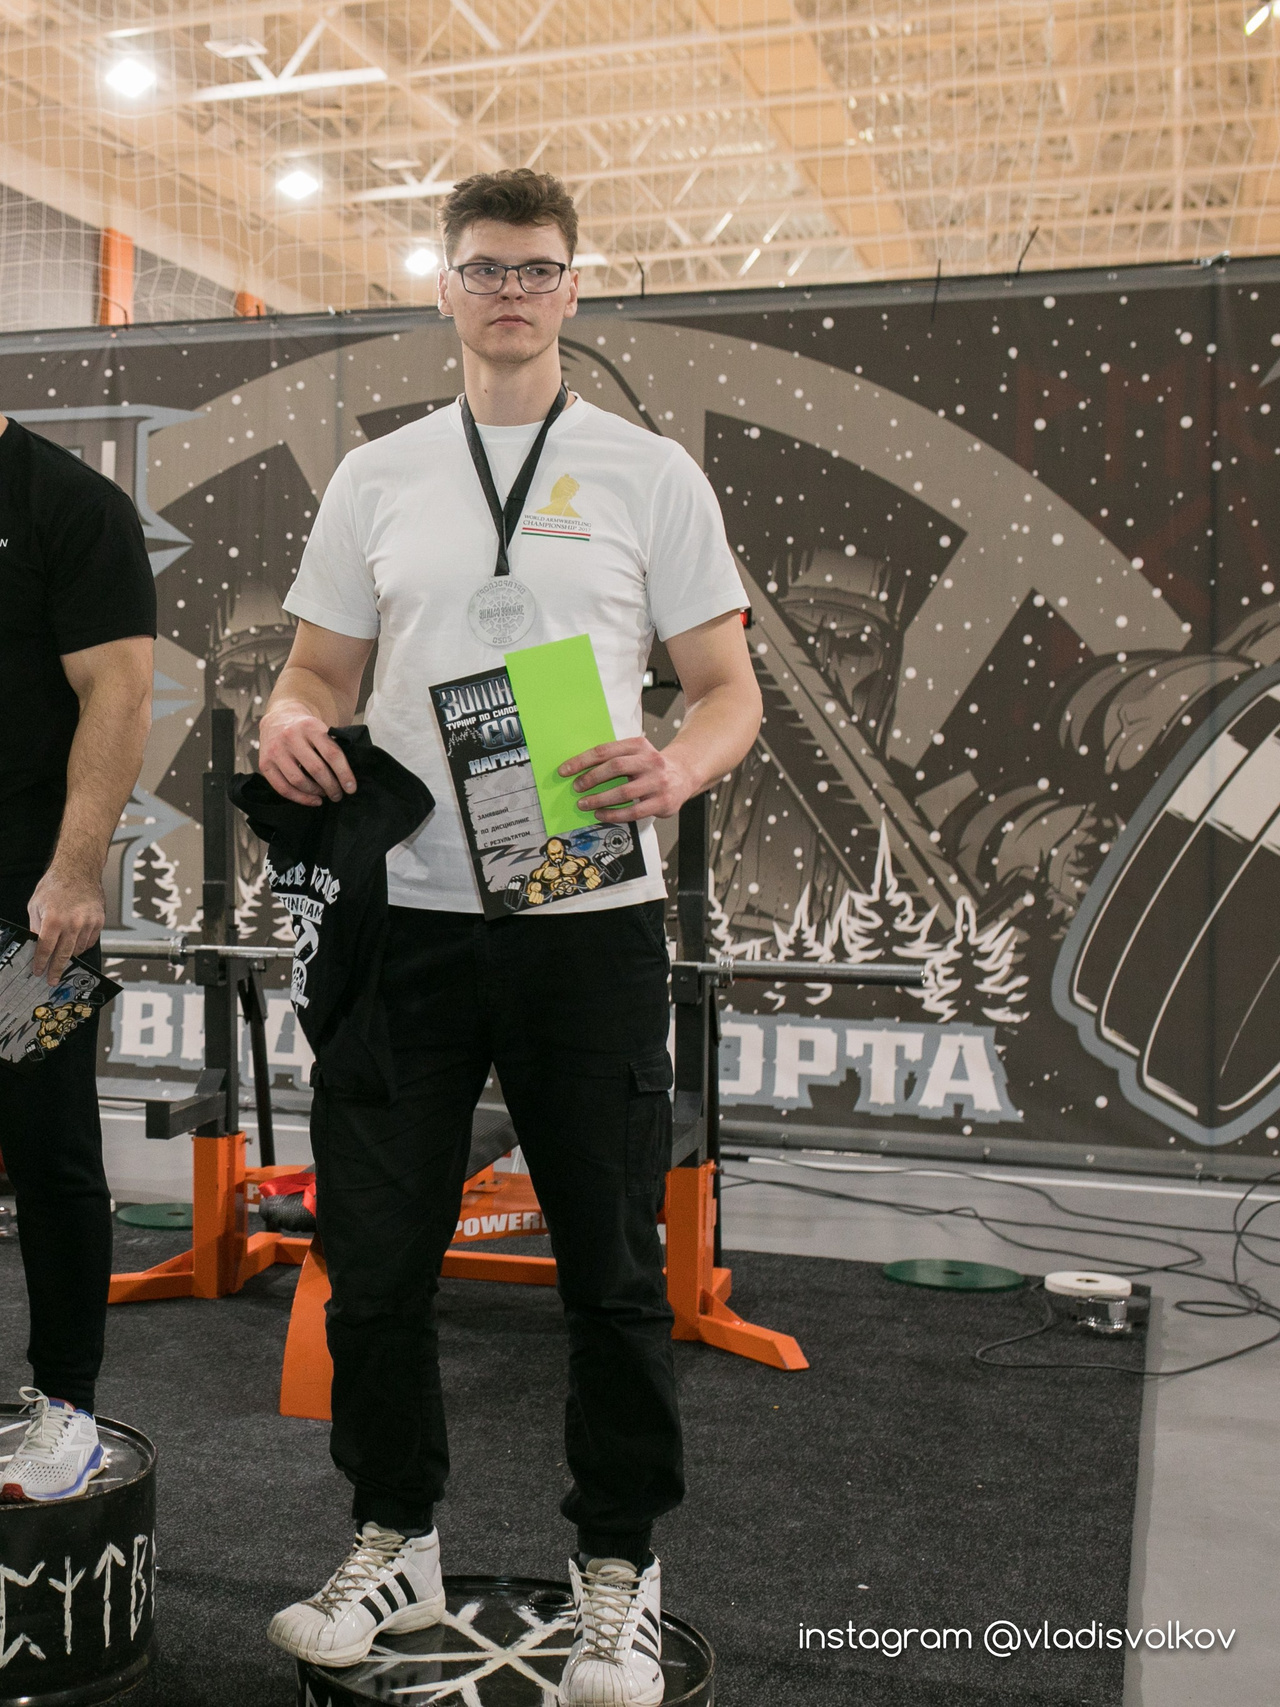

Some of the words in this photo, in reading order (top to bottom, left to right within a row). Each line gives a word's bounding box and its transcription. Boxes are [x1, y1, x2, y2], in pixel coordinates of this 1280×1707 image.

[523, 520, 578, 531] CHAMPIONSHIP
[524, 514, 545, 522] WORLD
[546, 517, 592, 528] ARMWRESTLING
[437, 676, 515, 722] ЗИМН
[446, 717, 477, 731] ТУРНИР
[479, 712, 491, 722] ПО
[492, 705, 519, 718] СИЛОВ
[468, 746, 531, 776] НАГРАЖ
[477, 807, 509, 821] ЗАНЯВШИЙ
[480, 827, 490, 835] ПО
[491, 816, 531, 833] ДИСЦИПЛИНЕ
[490, 830, 532, 847] РЕЗУЛЬТАТОМ
[719, 1021, 1003, 1113] ОРТА
